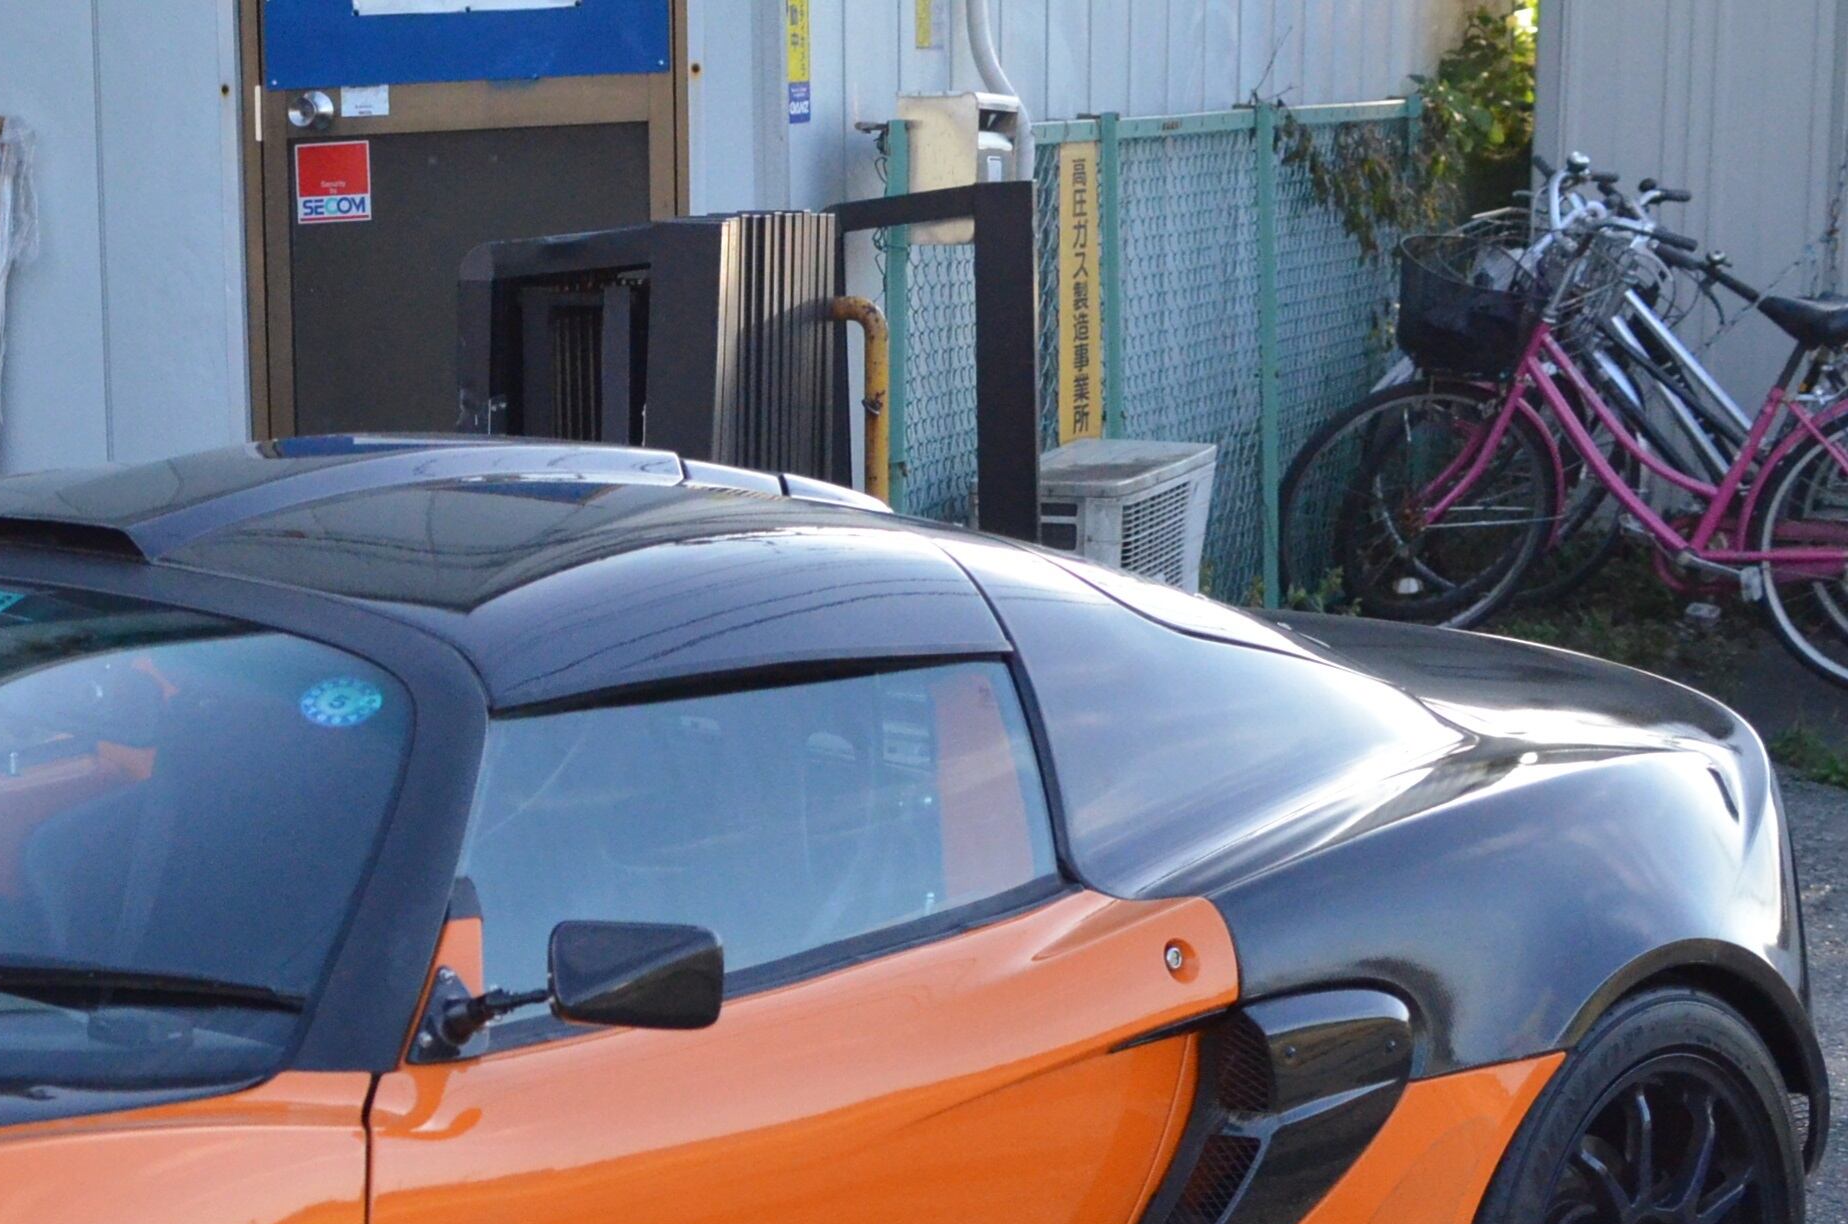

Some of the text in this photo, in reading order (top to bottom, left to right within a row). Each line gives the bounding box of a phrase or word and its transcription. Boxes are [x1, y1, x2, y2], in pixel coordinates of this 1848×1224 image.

[302, 196, 366, 216] SECOM
[1072, 158, 1090, 435] 高圧ガス製造事業所
